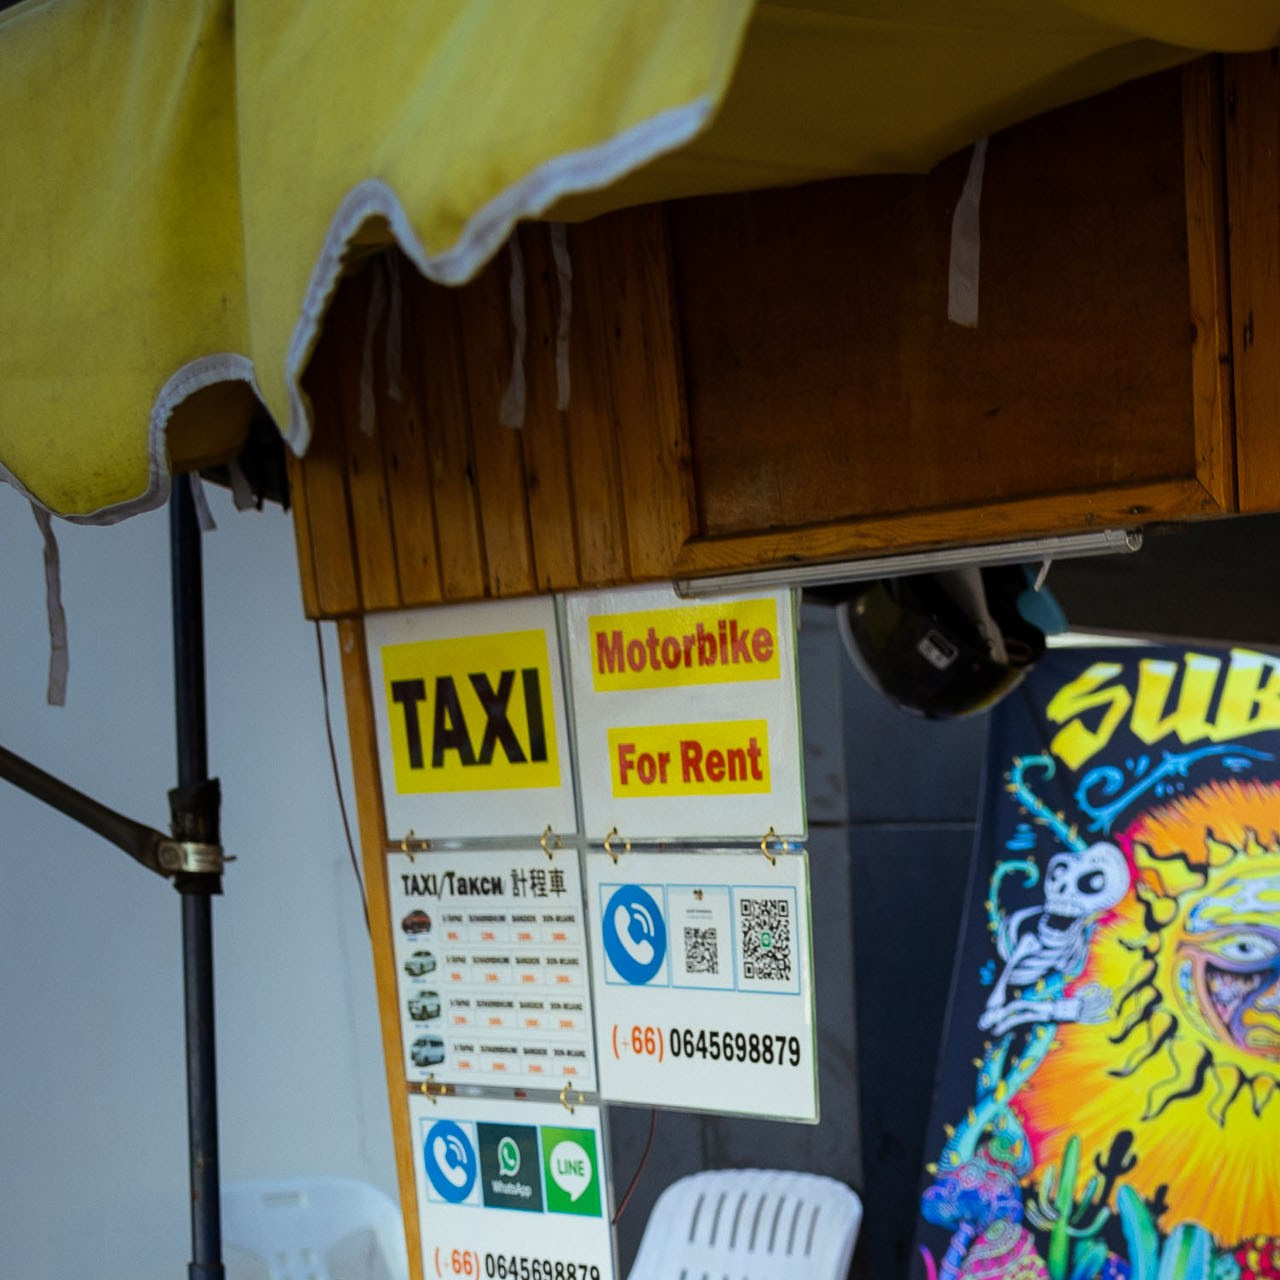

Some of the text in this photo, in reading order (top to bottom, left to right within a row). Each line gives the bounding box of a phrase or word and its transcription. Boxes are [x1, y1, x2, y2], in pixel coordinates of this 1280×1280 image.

[595, 619, 775, 676] Motorbike
[391, 667, 549, 770] TAXI
[618, 737, 764, 785] For Rent
[511, 869, 567, 898] 計程車
[670, 1027, 801, 1067] 0645698879
[557, 1158, 585, 1177] LINE
